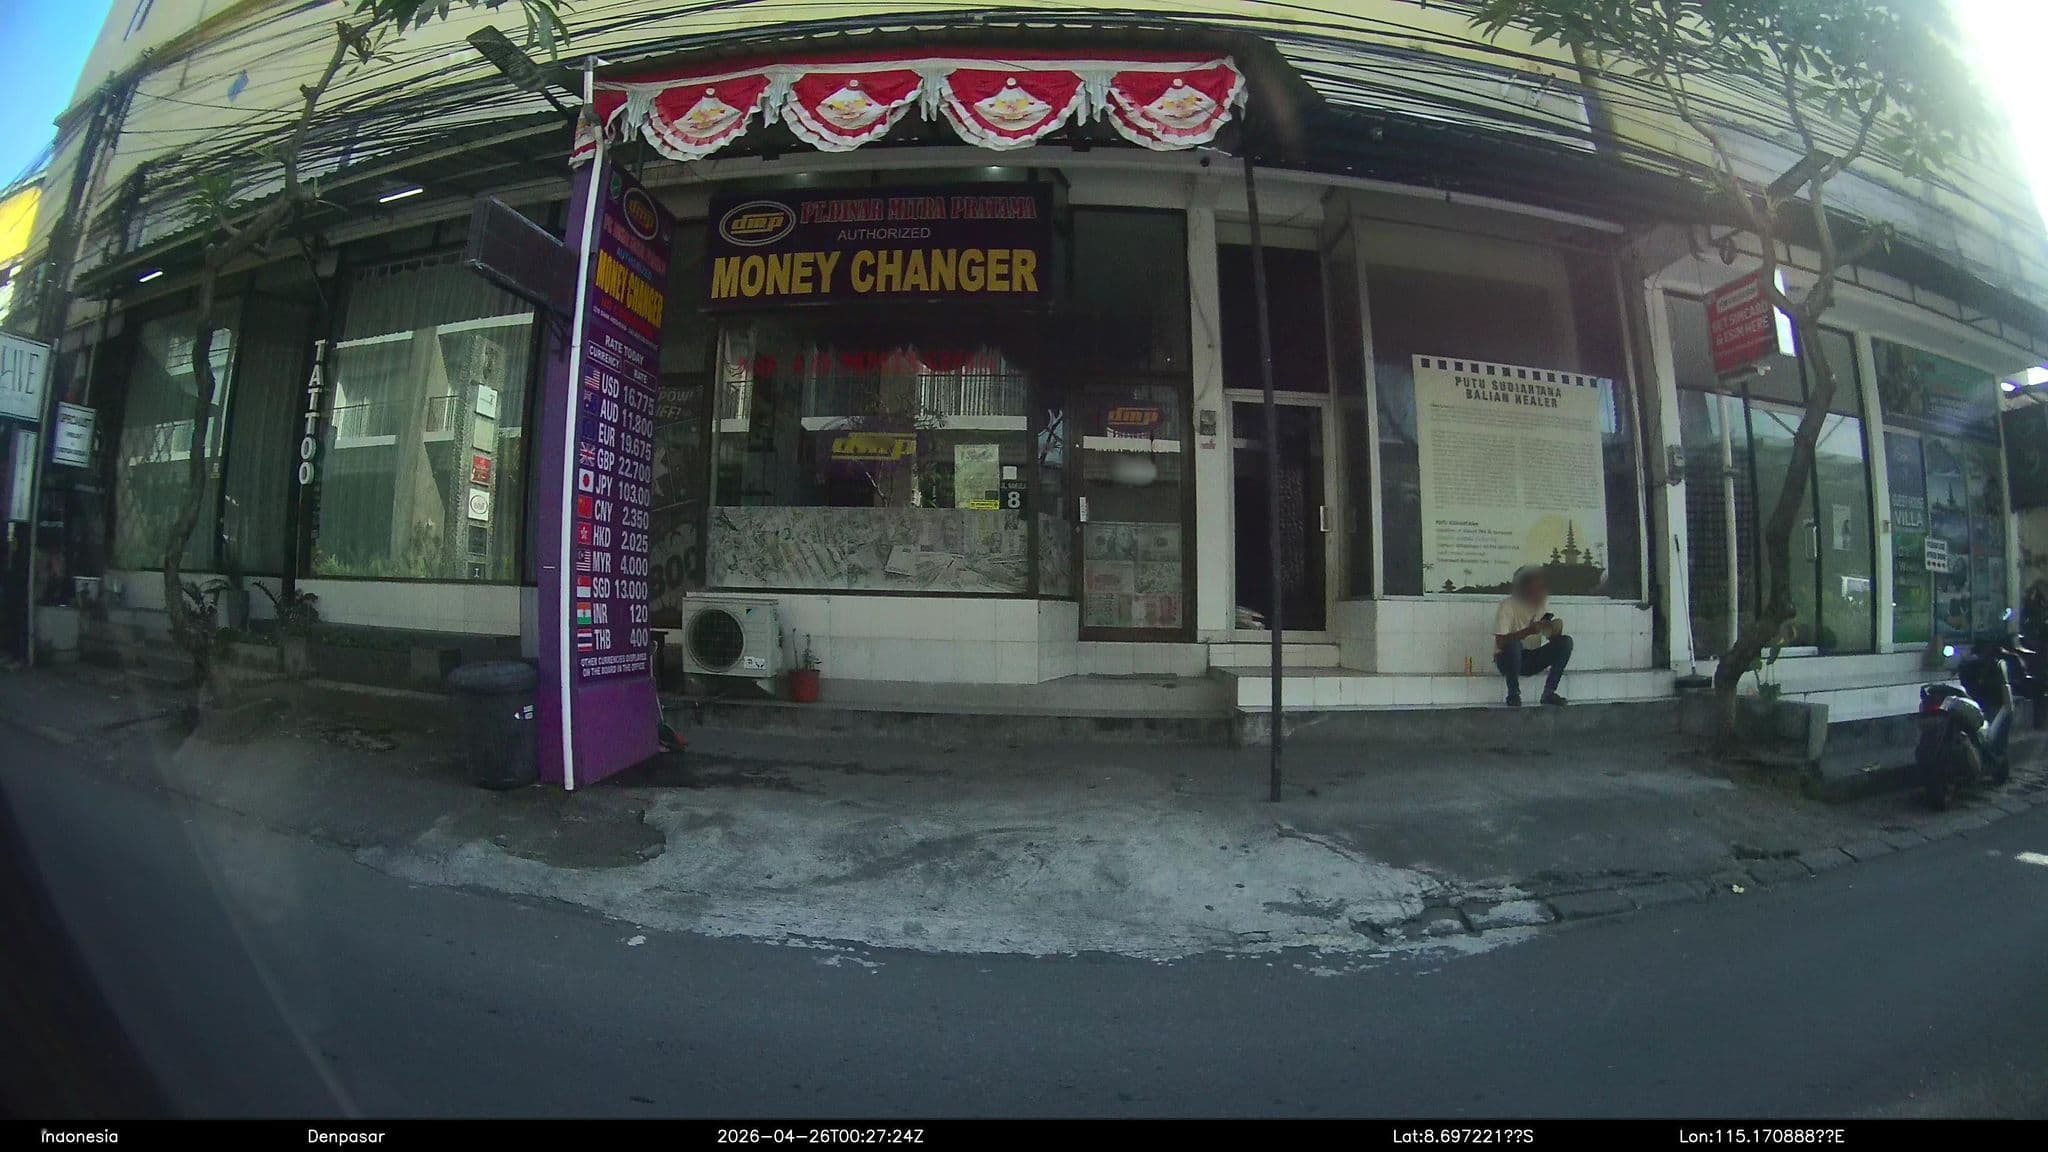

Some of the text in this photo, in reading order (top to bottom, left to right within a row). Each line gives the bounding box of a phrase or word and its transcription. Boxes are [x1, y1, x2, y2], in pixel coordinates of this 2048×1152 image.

[889, 197, 946, 220] MITRA
[950, 196, 1037, 219] PRATAMA
[838, 227, 931, 242] AUTHORIZED
[595, 248, 629, 303] MONEY
[626, 271, 664, 328] CHANGER
[711, 248, 1039, 299] MONEY CHANGER
[589, 345, 649, 384] CURRENCY RATE
[605, 334, 645, 366] RATE TODAY
[601, 373, 655, 416] USD 16.775
[1455, 376, 1562, 398] PUTU SUDIARTANA
[1466, 388, 1557, 408] BALIAN HEALER
[299, 339, 326, 485] TATTOO
[600, 399, 653, 439] AUD 11.800
[598, 423, 652, 461] EUR 19.675
[597, 448, 651, 483] GBP 22.700
[595, 474, 650, 507] JPY 103.00
[1007, 491, 1021, 509] 8
[594, 499, 649, 530] CNY 2.350
[1894, 510, 1923, 527] VILLA
[593, 525, 649, 553] HKD 2.025
[592, 551, 648, 577] MYR 4.000
[592, 577, 648, 600] SGD 13.000
[593, 603, 648, 624] INR 120
[593, 628, 649, 650] THB 400
